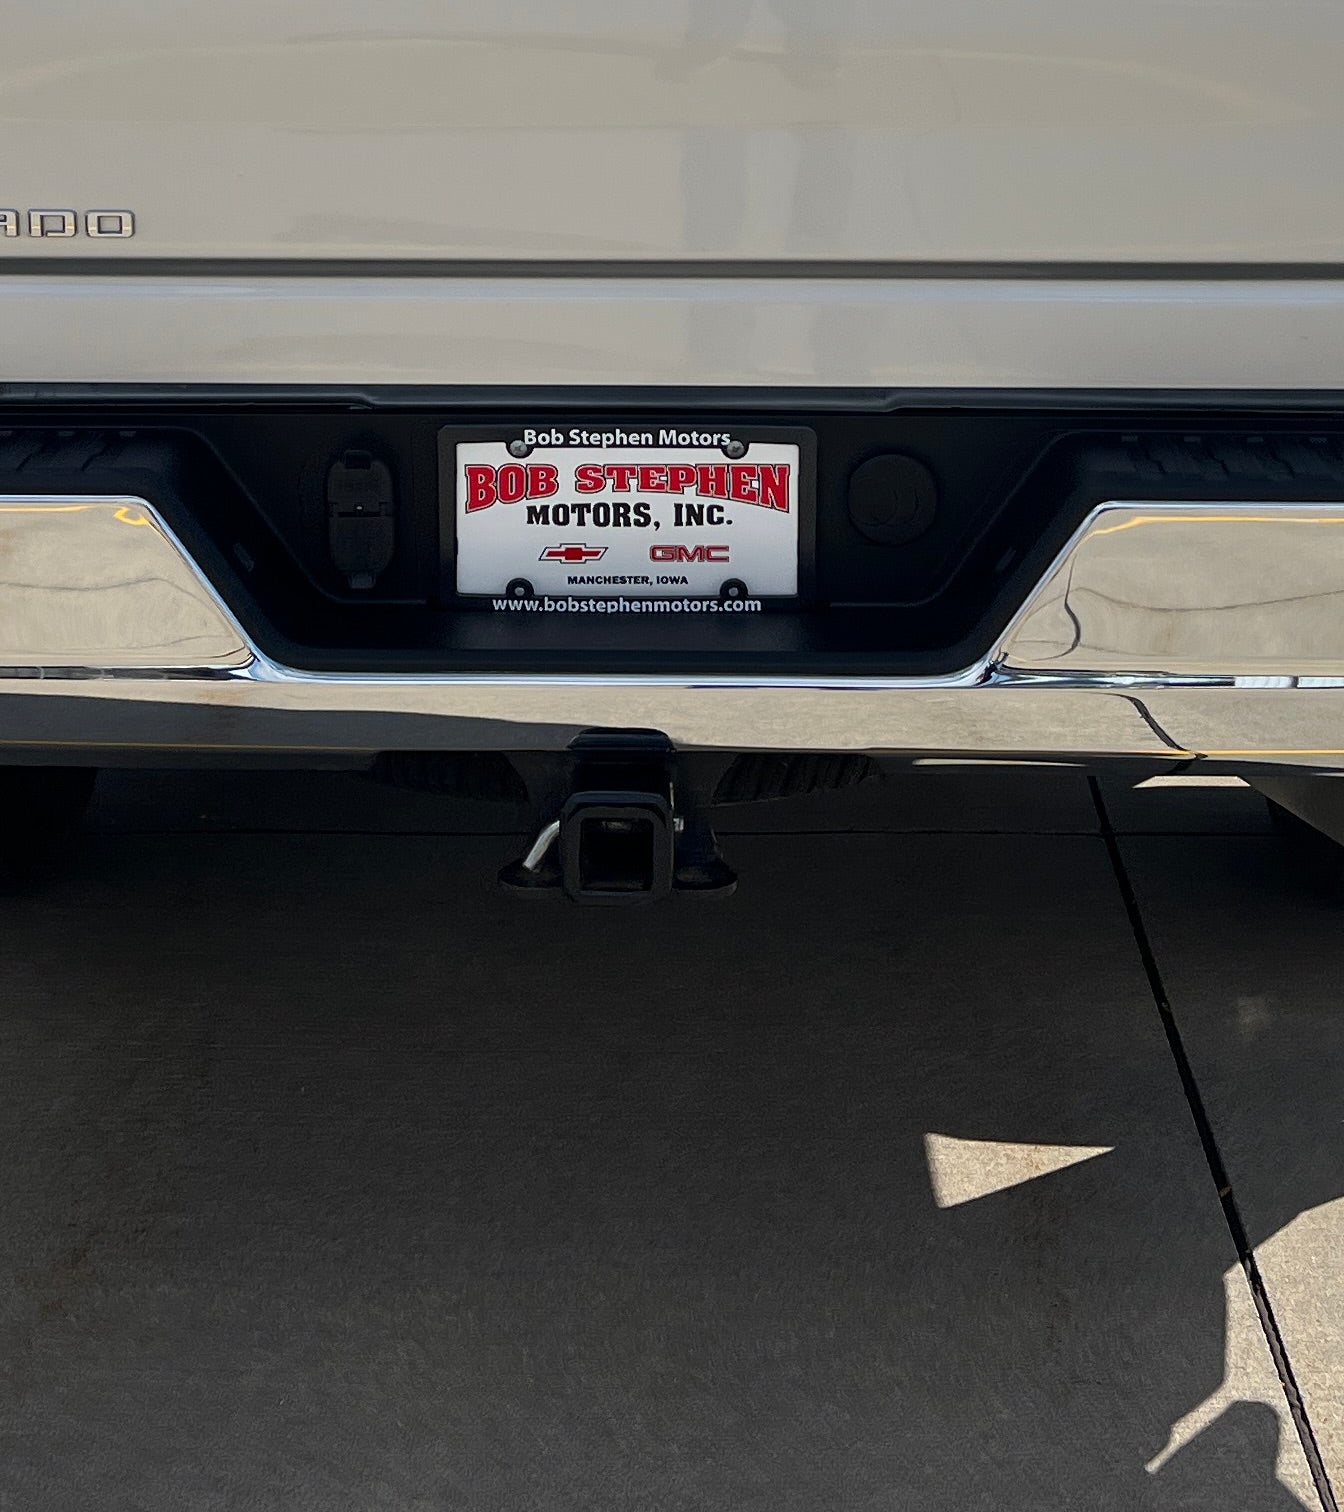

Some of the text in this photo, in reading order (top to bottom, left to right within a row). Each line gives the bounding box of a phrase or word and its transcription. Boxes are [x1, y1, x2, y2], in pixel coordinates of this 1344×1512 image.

[524, 429, 731, 449] Bob Stephen Motors
[464, 463, 791, 514] BOB STEPHEN
[526, 502, 733, 531] MOTORS, INC.
[649, 544, 730, 563] GMC
[567, 575, 688, 586] MANCHESTER, IOWA
[492, 597, 762, 614] www.bobstephenmotors.com
